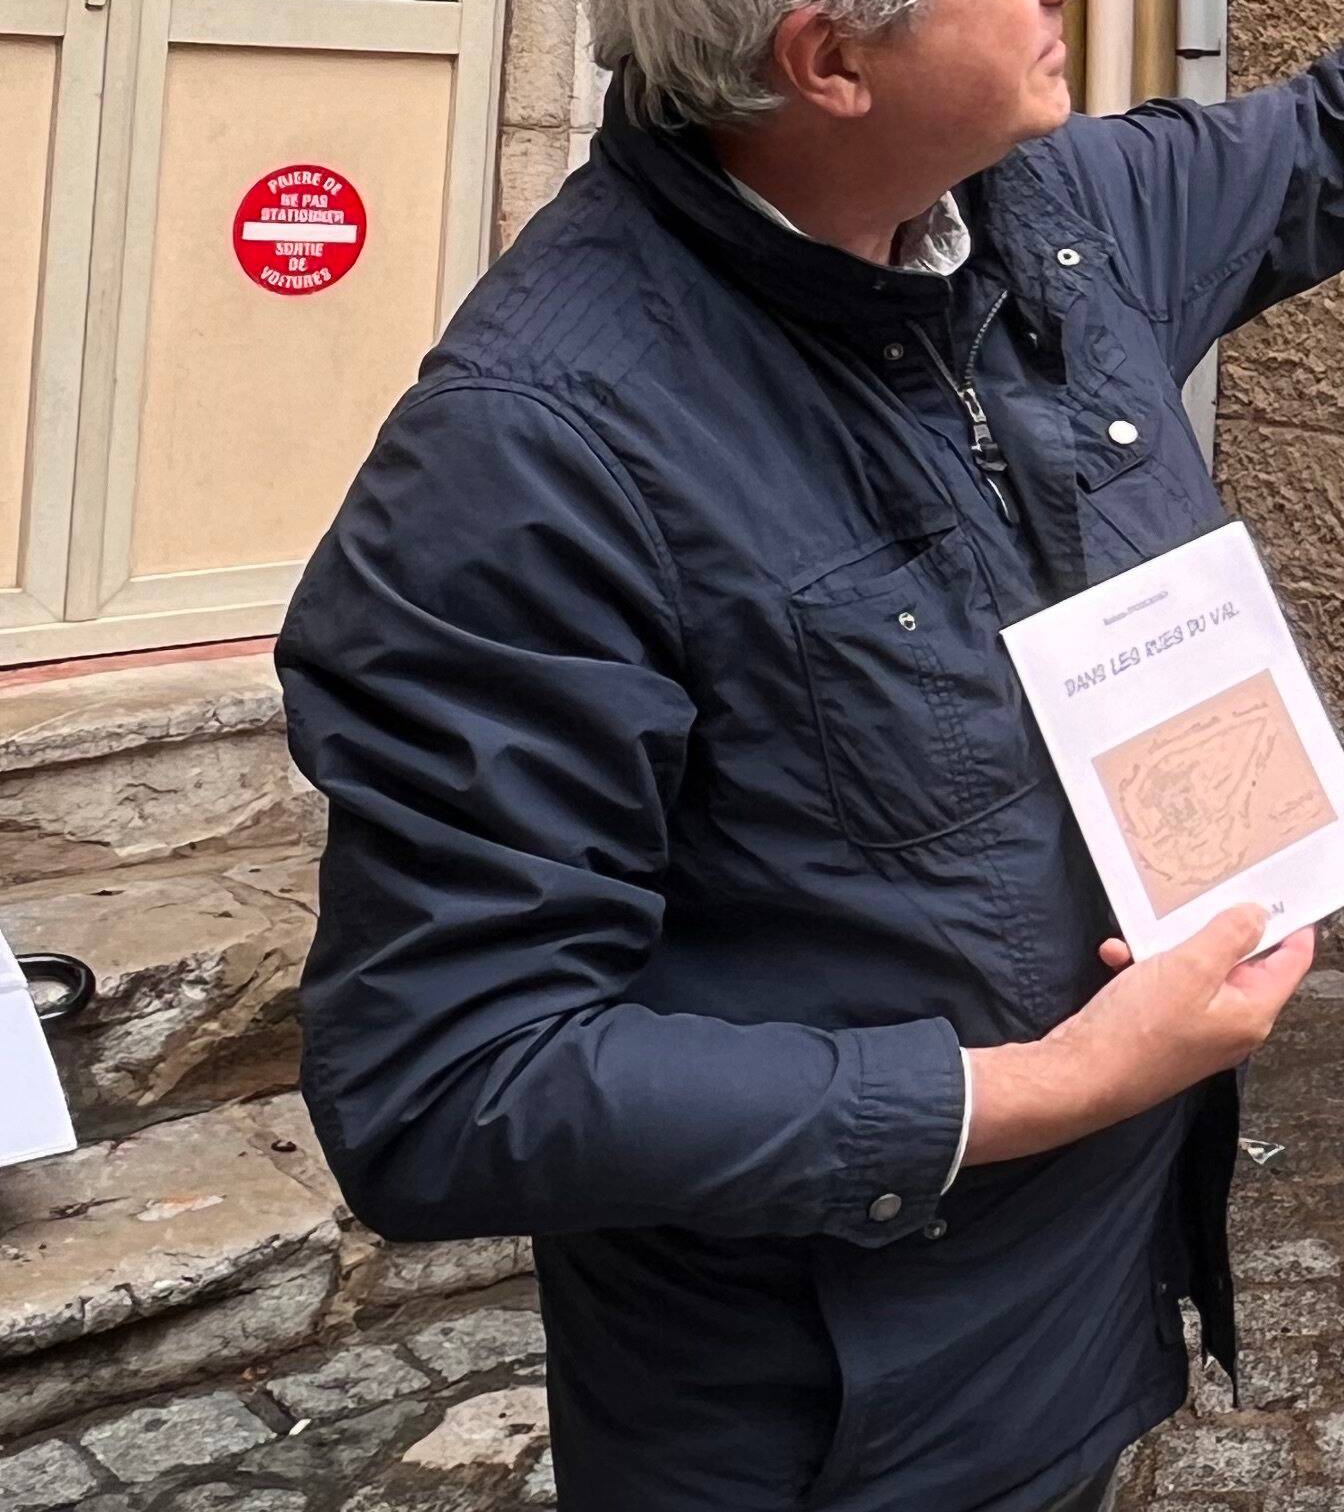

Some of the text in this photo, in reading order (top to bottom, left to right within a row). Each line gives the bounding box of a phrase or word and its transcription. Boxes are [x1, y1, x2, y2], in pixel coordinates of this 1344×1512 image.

[323, 177, 342, 196] DE
[280, 193, 328, 208] NE PAS
[275, 242, 324, 257] SORTIE
[288, 257, 307, 271] DE
[260, 266, 332, 288] VOITURES
[1064, 663, 1106, 697] DANS
[1110, 646, 1141, 675] LES
[1187, 614, 1206, 637] DU
[1209, 601, 1240, 625] VAL
